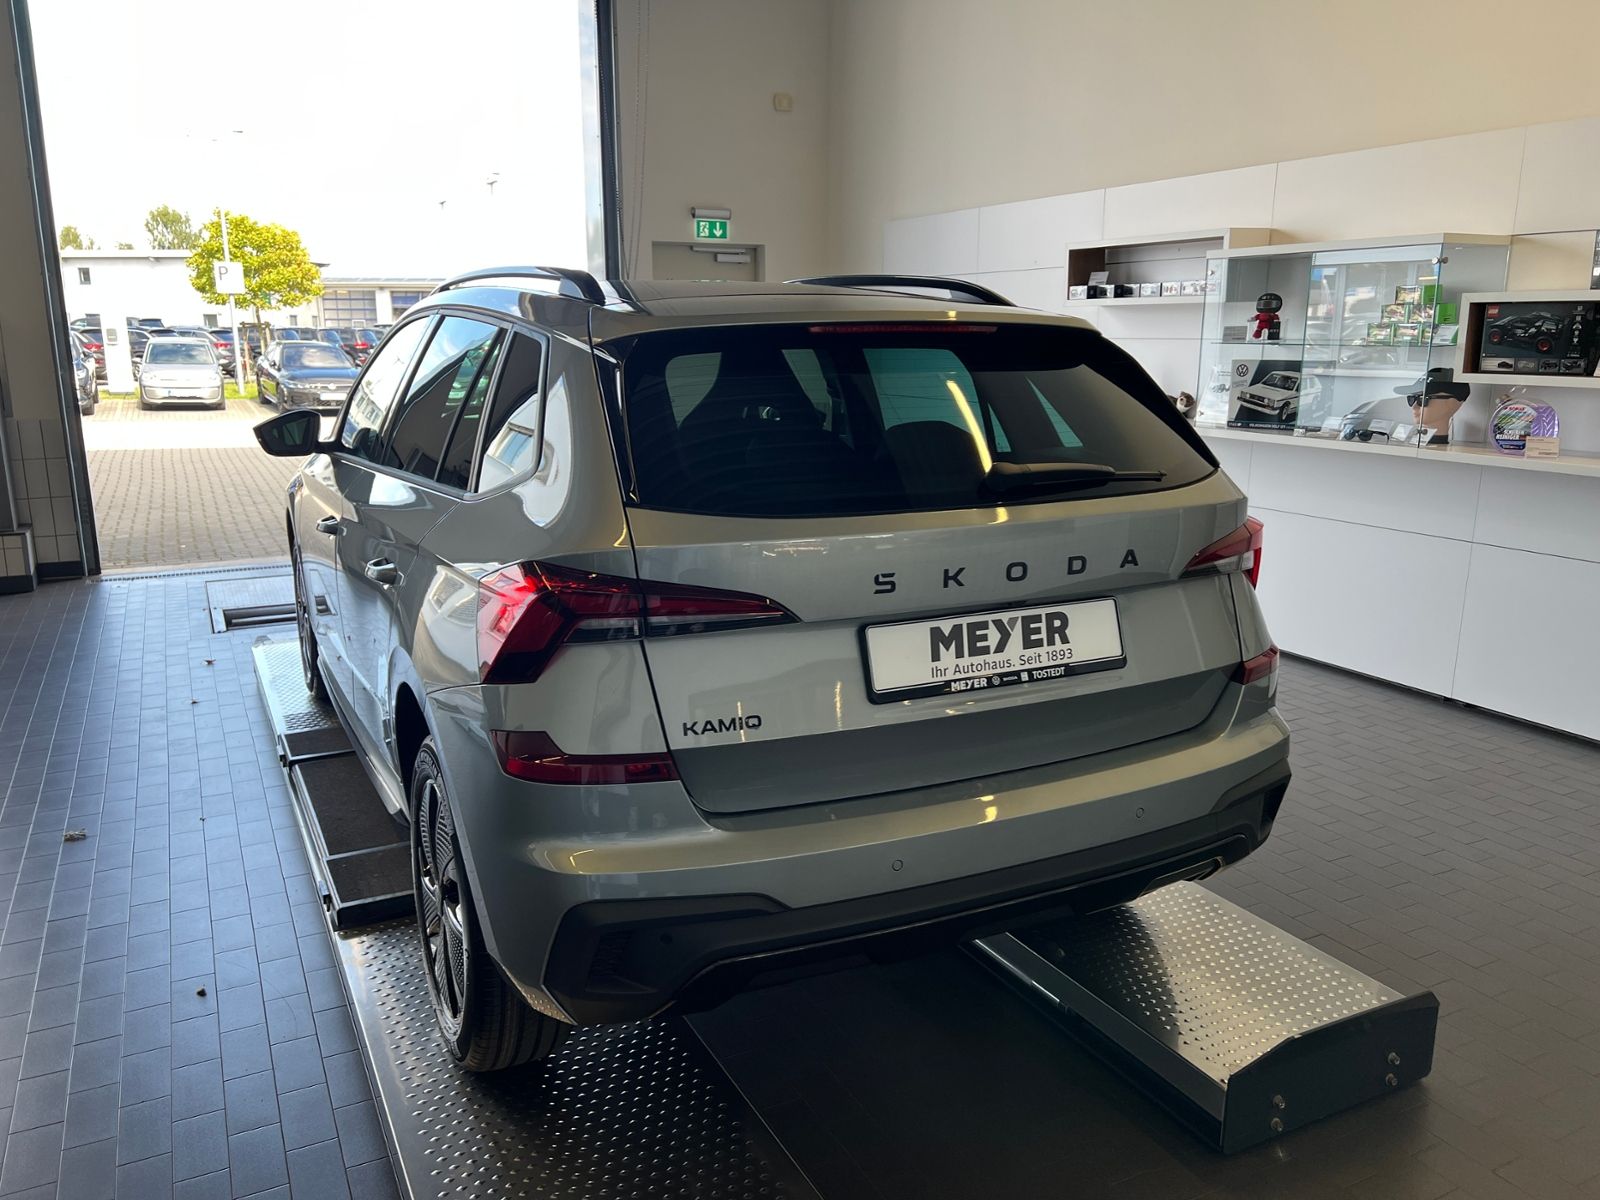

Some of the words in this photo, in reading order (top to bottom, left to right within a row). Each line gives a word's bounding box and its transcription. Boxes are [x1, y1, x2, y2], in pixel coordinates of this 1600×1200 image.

[218, 265, 229, 281] P
[873, 549, 1139, 595] SKODA
[930, 611, 1071, 662] MEYER
[931, 666, 949, 679] Ihr
[953, 659, 1016, 676] Autohaus.
[1019, 652, 1042, 667] Seit
[1045, 648, 1074, 663] 1893
[951, 677, 988, 692] MEYER
[1032, 666, 1066, 679] TOSTEDT
[682, 714, 763, 737] KAMIQ
